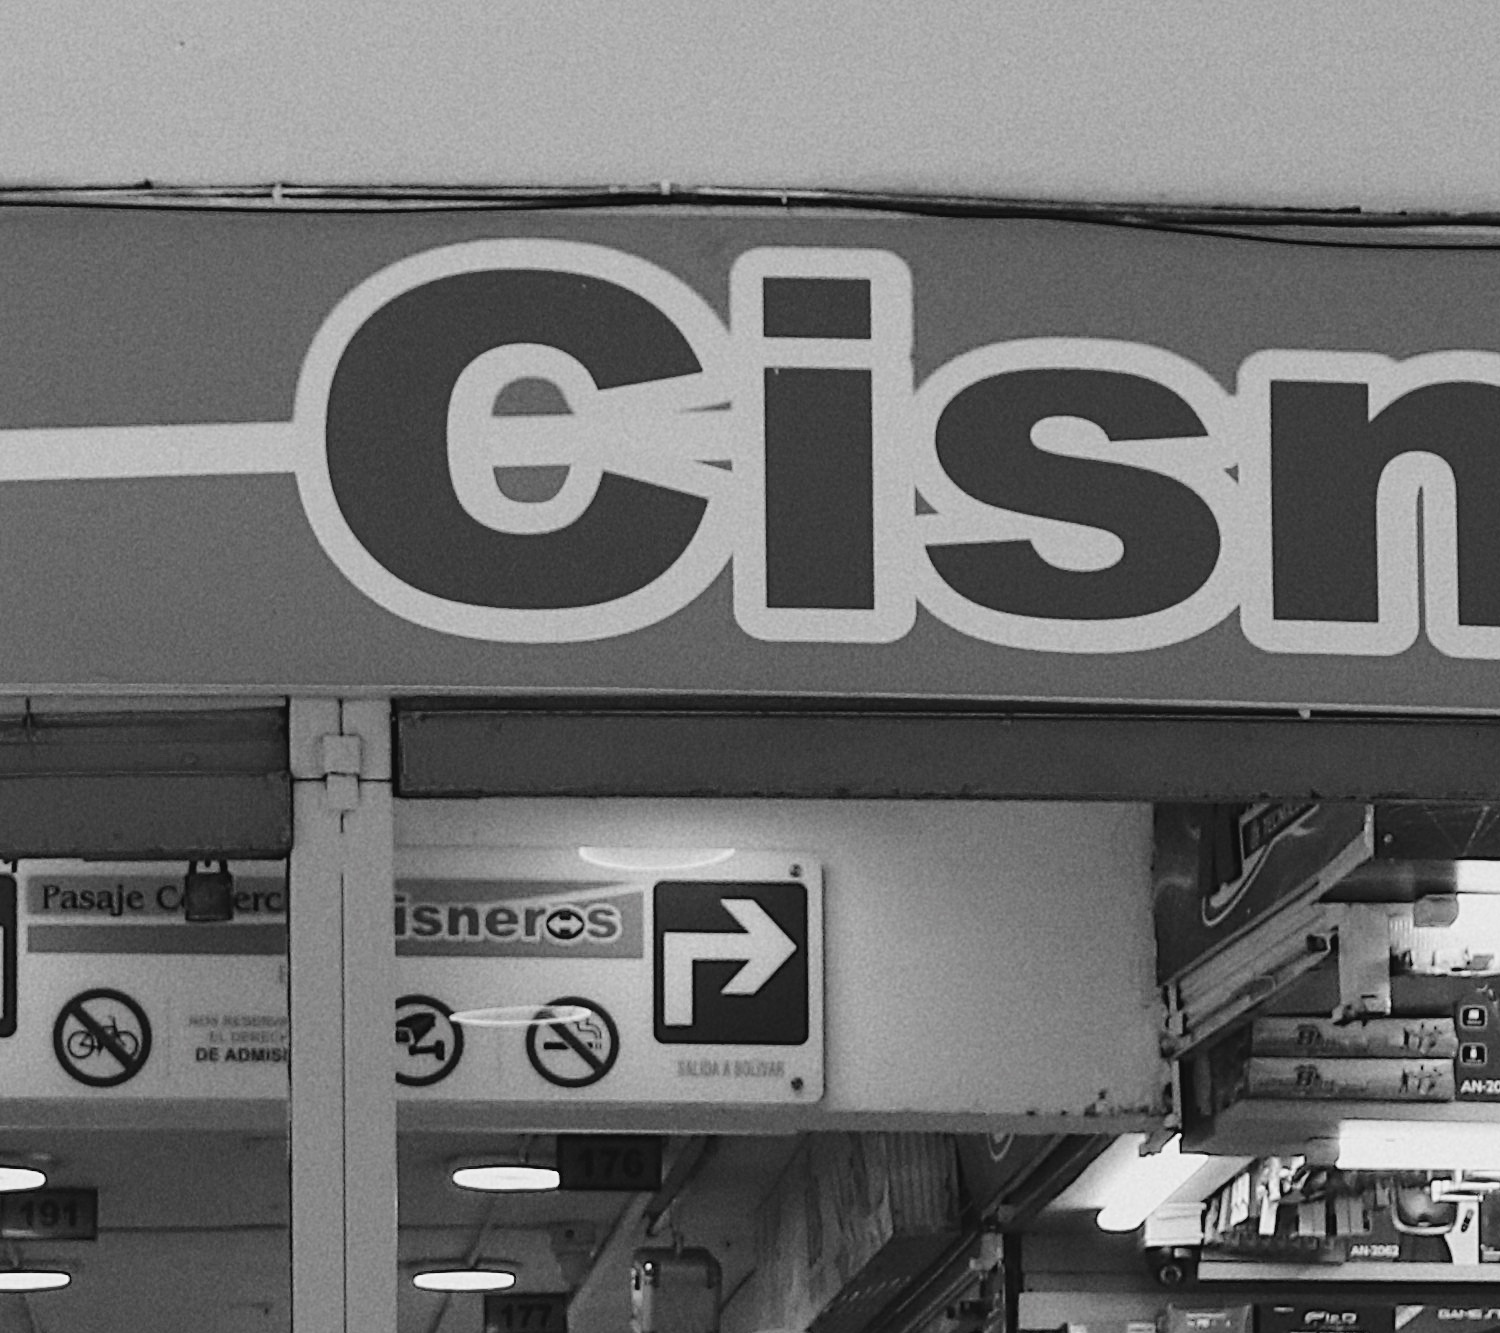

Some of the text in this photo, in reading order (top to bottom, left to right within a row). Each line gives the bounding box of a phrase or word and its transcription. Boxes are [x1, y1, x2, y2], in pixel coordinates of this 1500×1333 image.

[41, 882, 145, 917] Pasaje
[195, 1046, 220, 1062] DE
[18, 1199, 79, 1227] 191
[499, 1303, 552, 1330] 177
